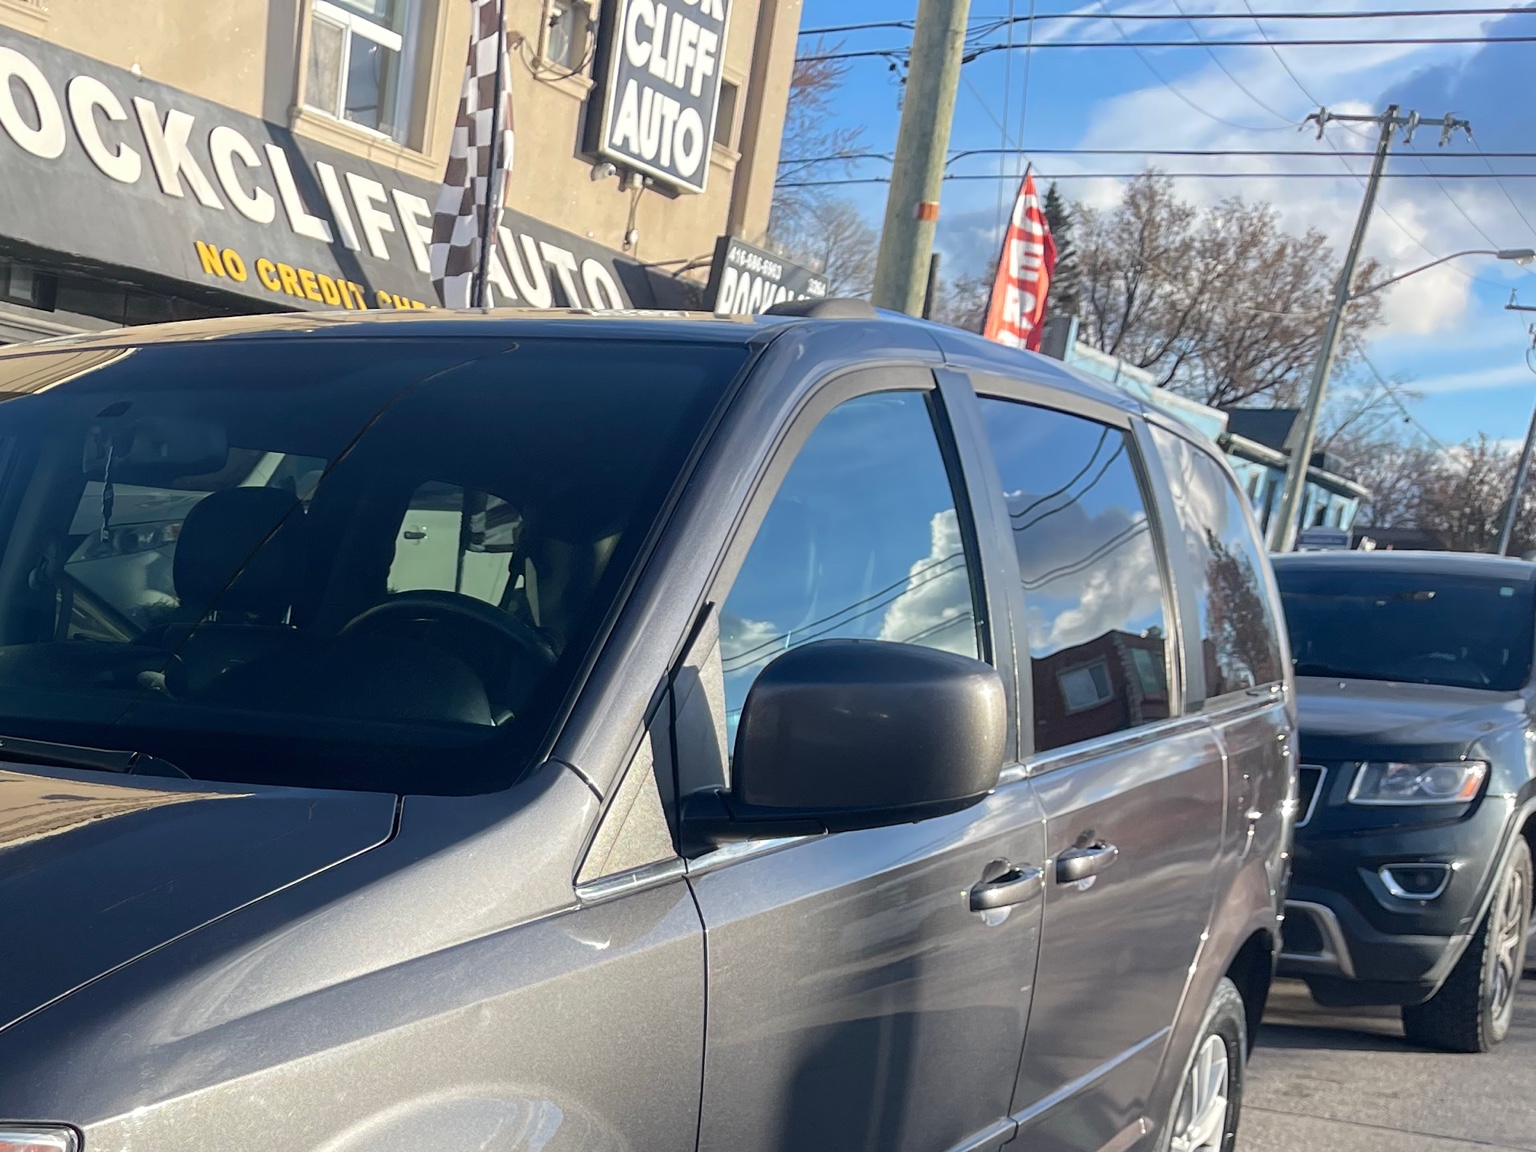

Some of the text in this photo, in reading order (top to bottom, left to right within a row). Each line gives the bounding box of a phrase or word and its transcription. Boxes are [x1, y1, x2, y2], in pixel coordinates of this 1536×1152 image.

[625, 0, 718, 97] CLIFF
[612, 78, 704, 177] AUTO
[195, 240, 247, 282] NO
[255, 257, 368, 311] CREDIT
[485, 226, 626, 309] AUTO
